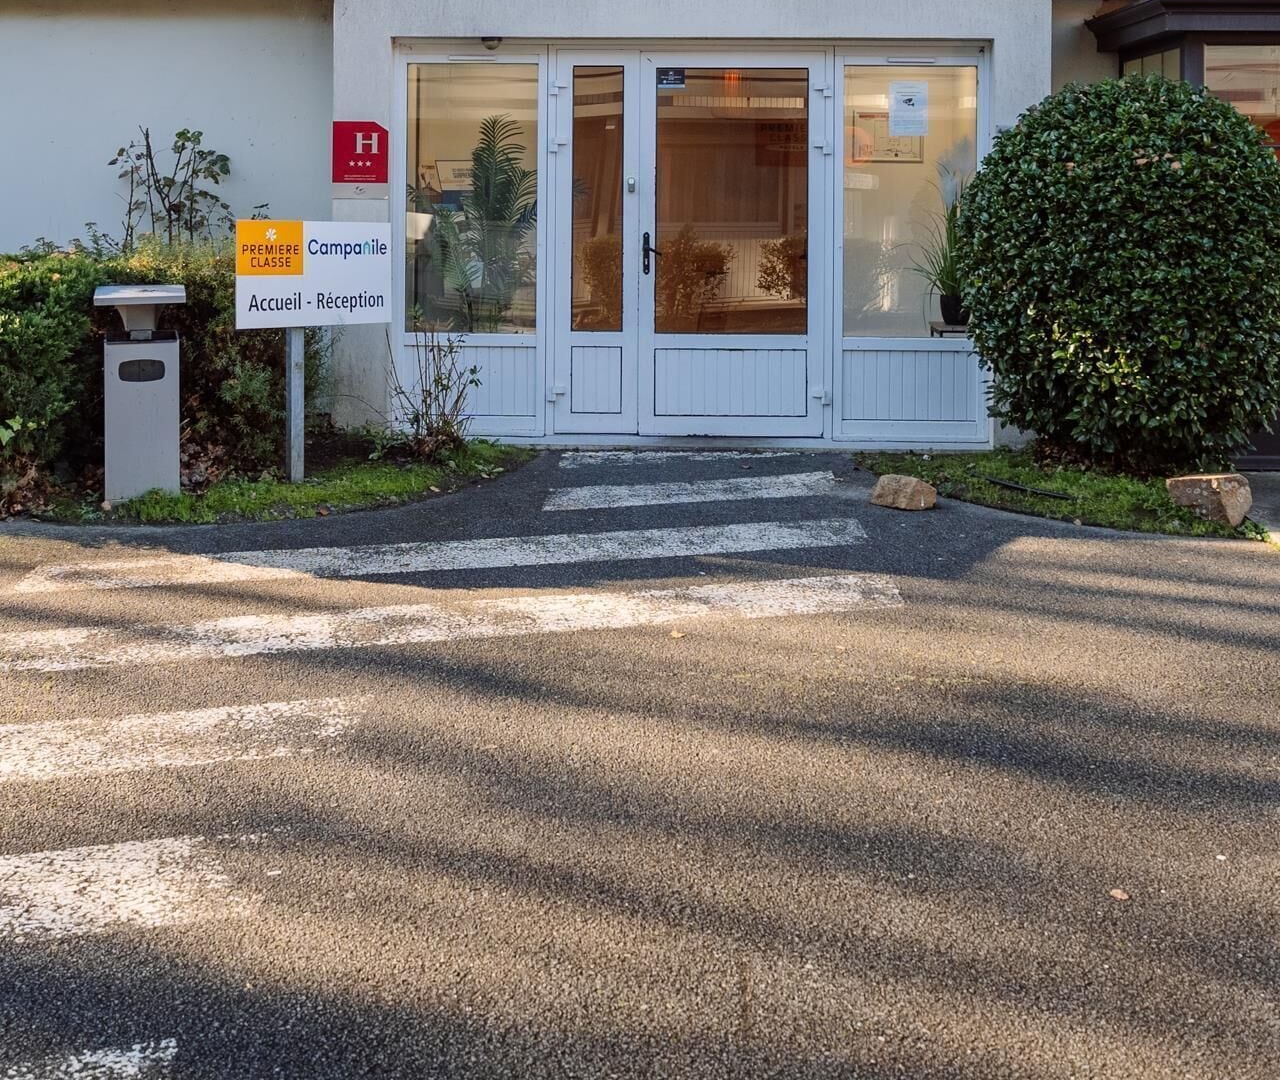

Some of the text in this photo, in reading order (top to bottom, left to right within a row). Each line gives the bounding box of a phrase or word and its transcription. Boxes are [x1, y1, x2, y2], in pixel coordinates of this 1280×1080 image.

[353, 132, 381, 154] H
[242, 244, 300, 255] PREMIERE
[307, 239, 388, 259] Campanile
[250, 256, 292, 268] CLASSE
[248, 291, 302, 312] Accueil
[317, 290, 384, 312] Réception
